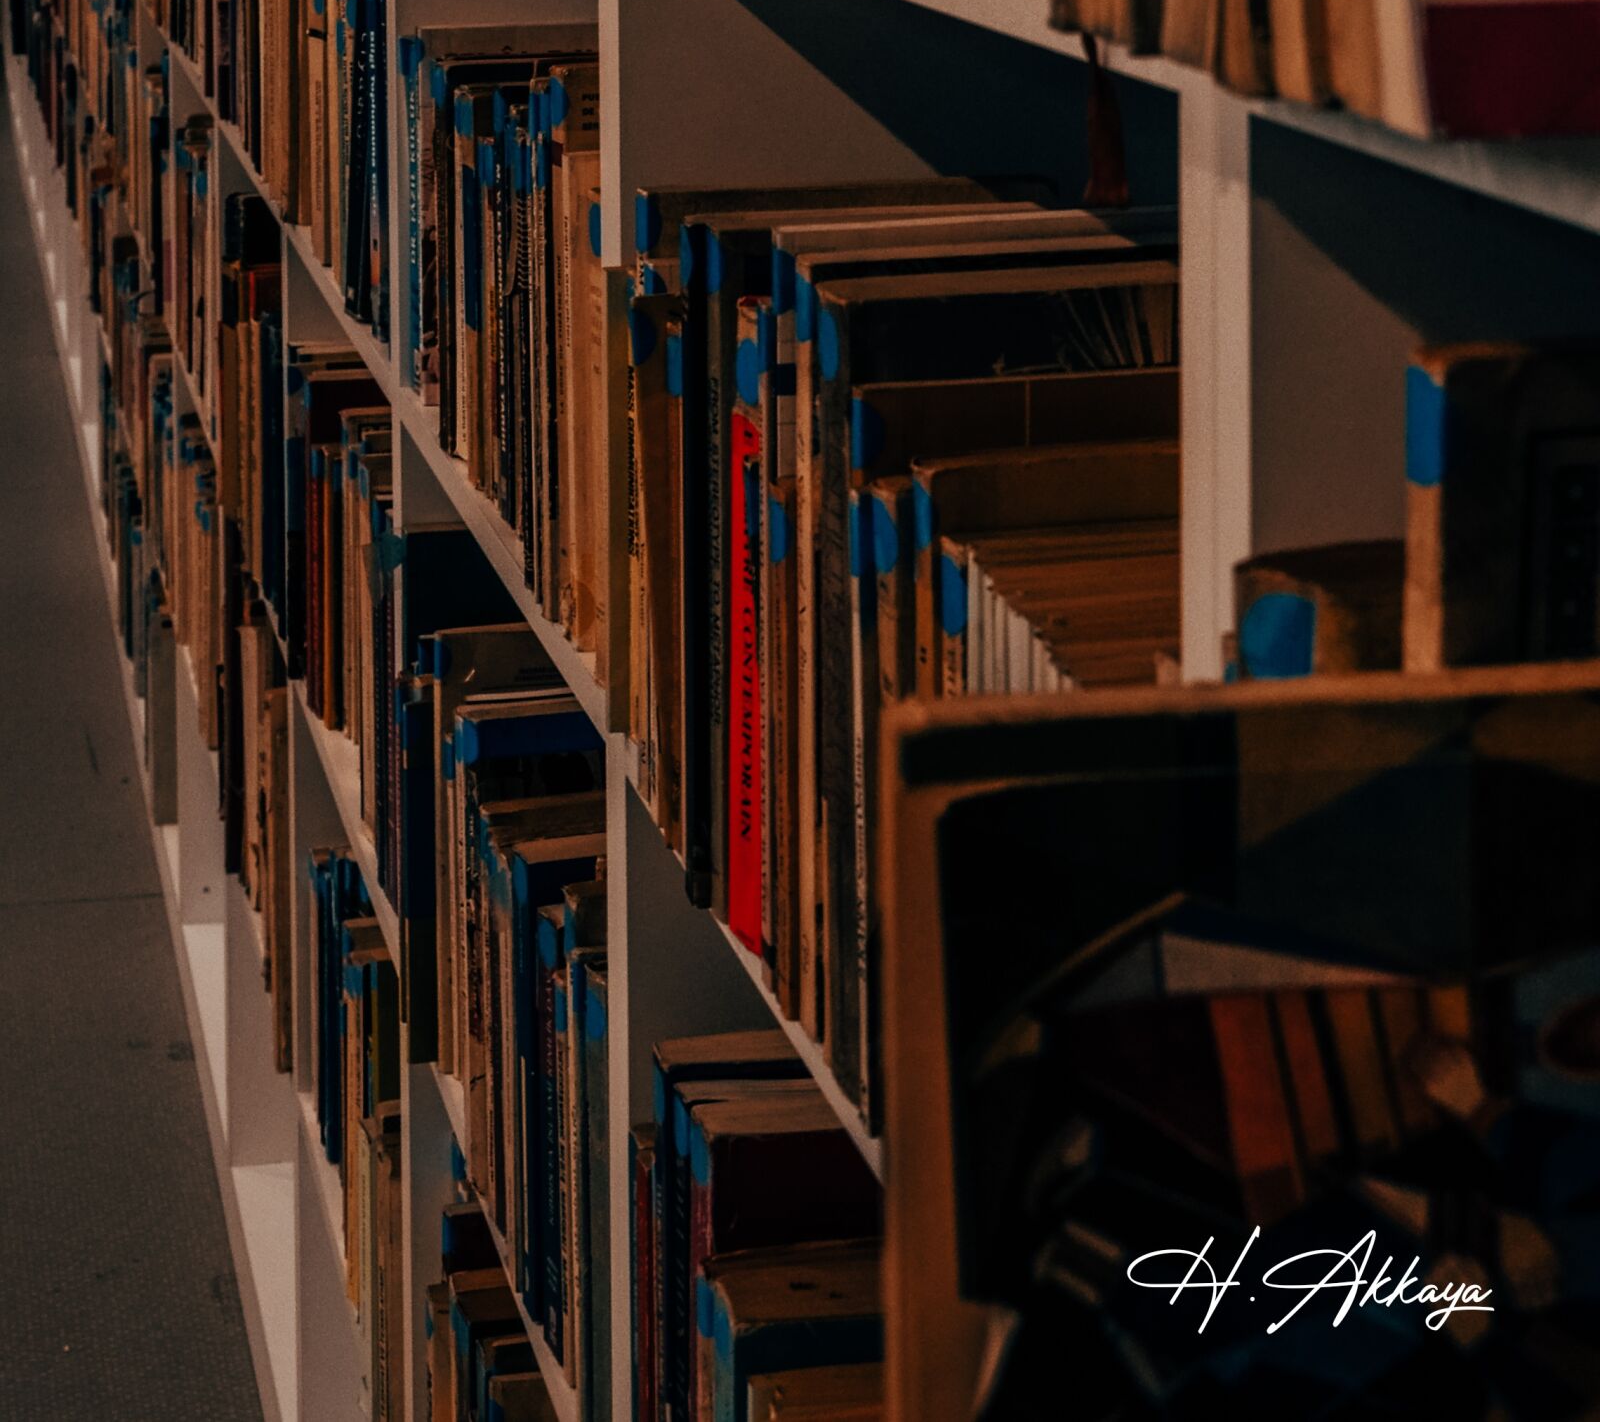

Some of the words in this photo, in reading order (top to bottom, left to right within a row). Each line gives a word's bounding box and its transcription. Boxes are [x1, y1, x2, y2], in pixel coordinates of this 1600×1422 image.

[369, 30, 378, 70] Bilgi
[369, 74, 378, 168] Toplumuna
[626, 364, 637, 413] MASS
[711, 376, 721, 435] FROM
[626, 416, 637, 558] COMMUNICATIONS
[711, 441, 722, 565] STEREOTYPE
[711, 578, 722, 605] TO
[711, 614, 722, 726] METAPHOR
[740, 606, 755, 842] CONTEMPORAIN
